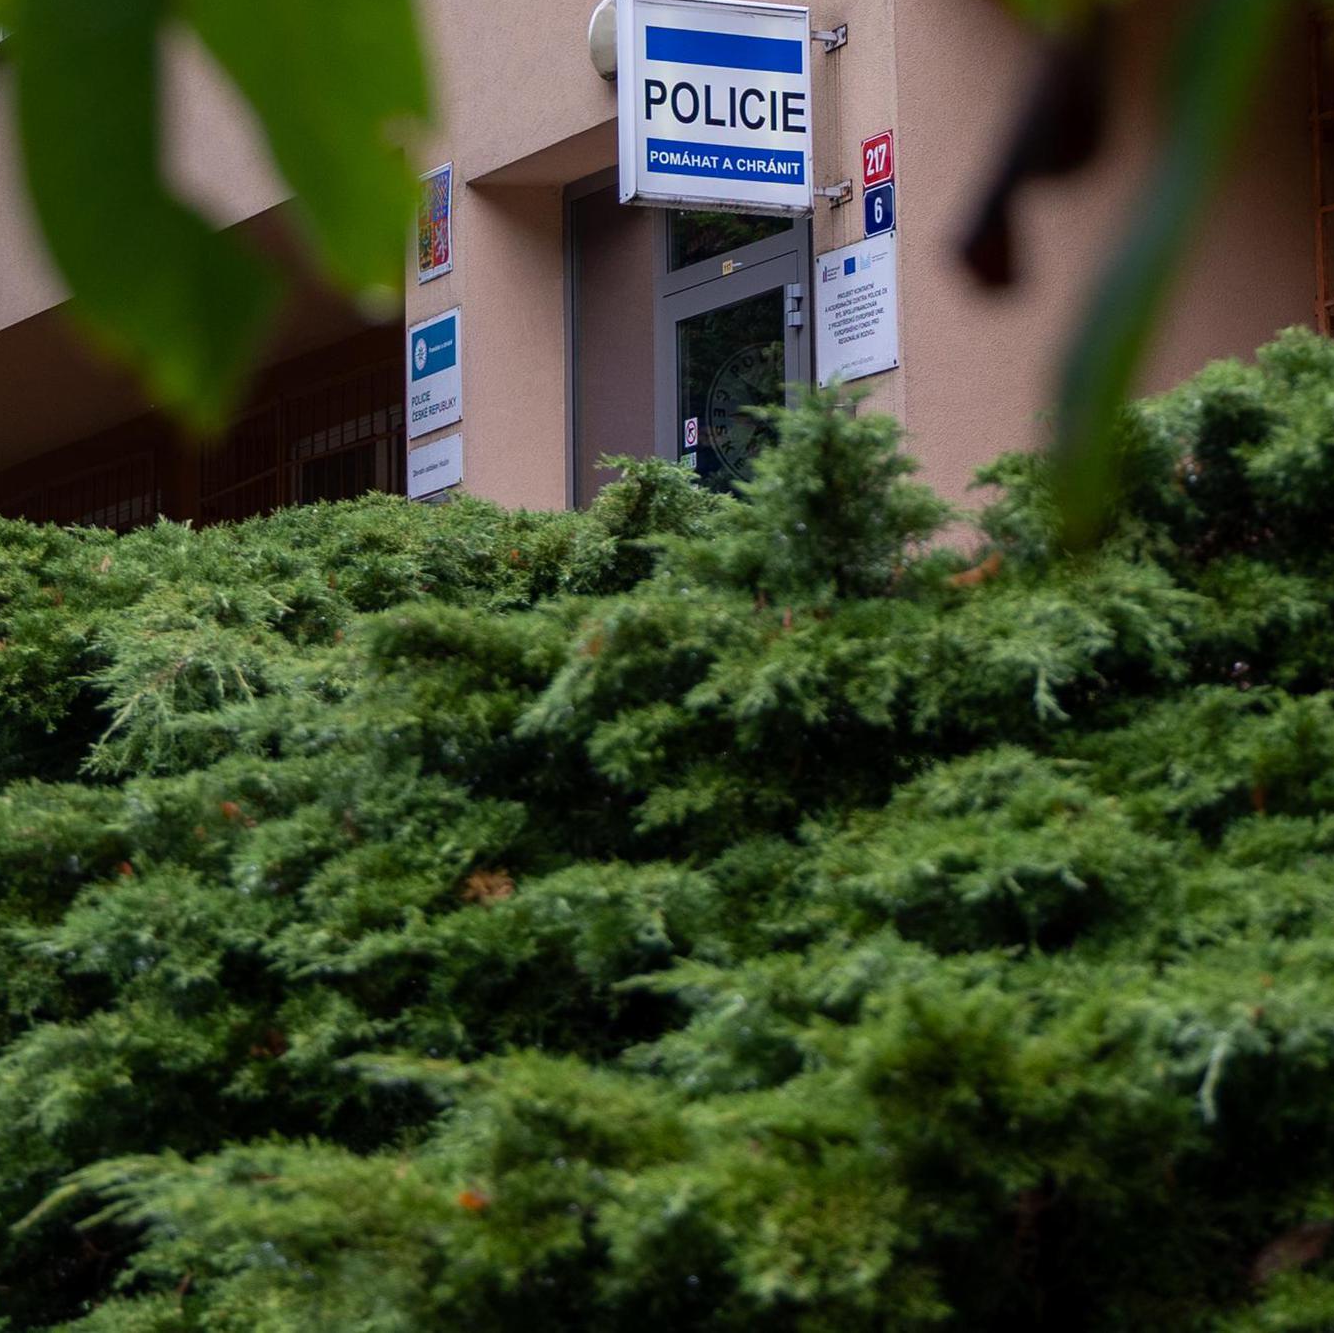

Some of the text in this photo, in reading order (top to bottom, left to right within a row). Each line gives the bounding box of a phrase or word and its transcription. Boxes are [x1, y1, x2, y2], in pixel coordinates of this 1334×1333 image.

[644, 78, 807, 133] POLICIE
[650, 151, 800, 175] POMÁHAT A CHRÁNIT
[866, 143, 887, 176] 217
[874, 197, 883, 224] 6
